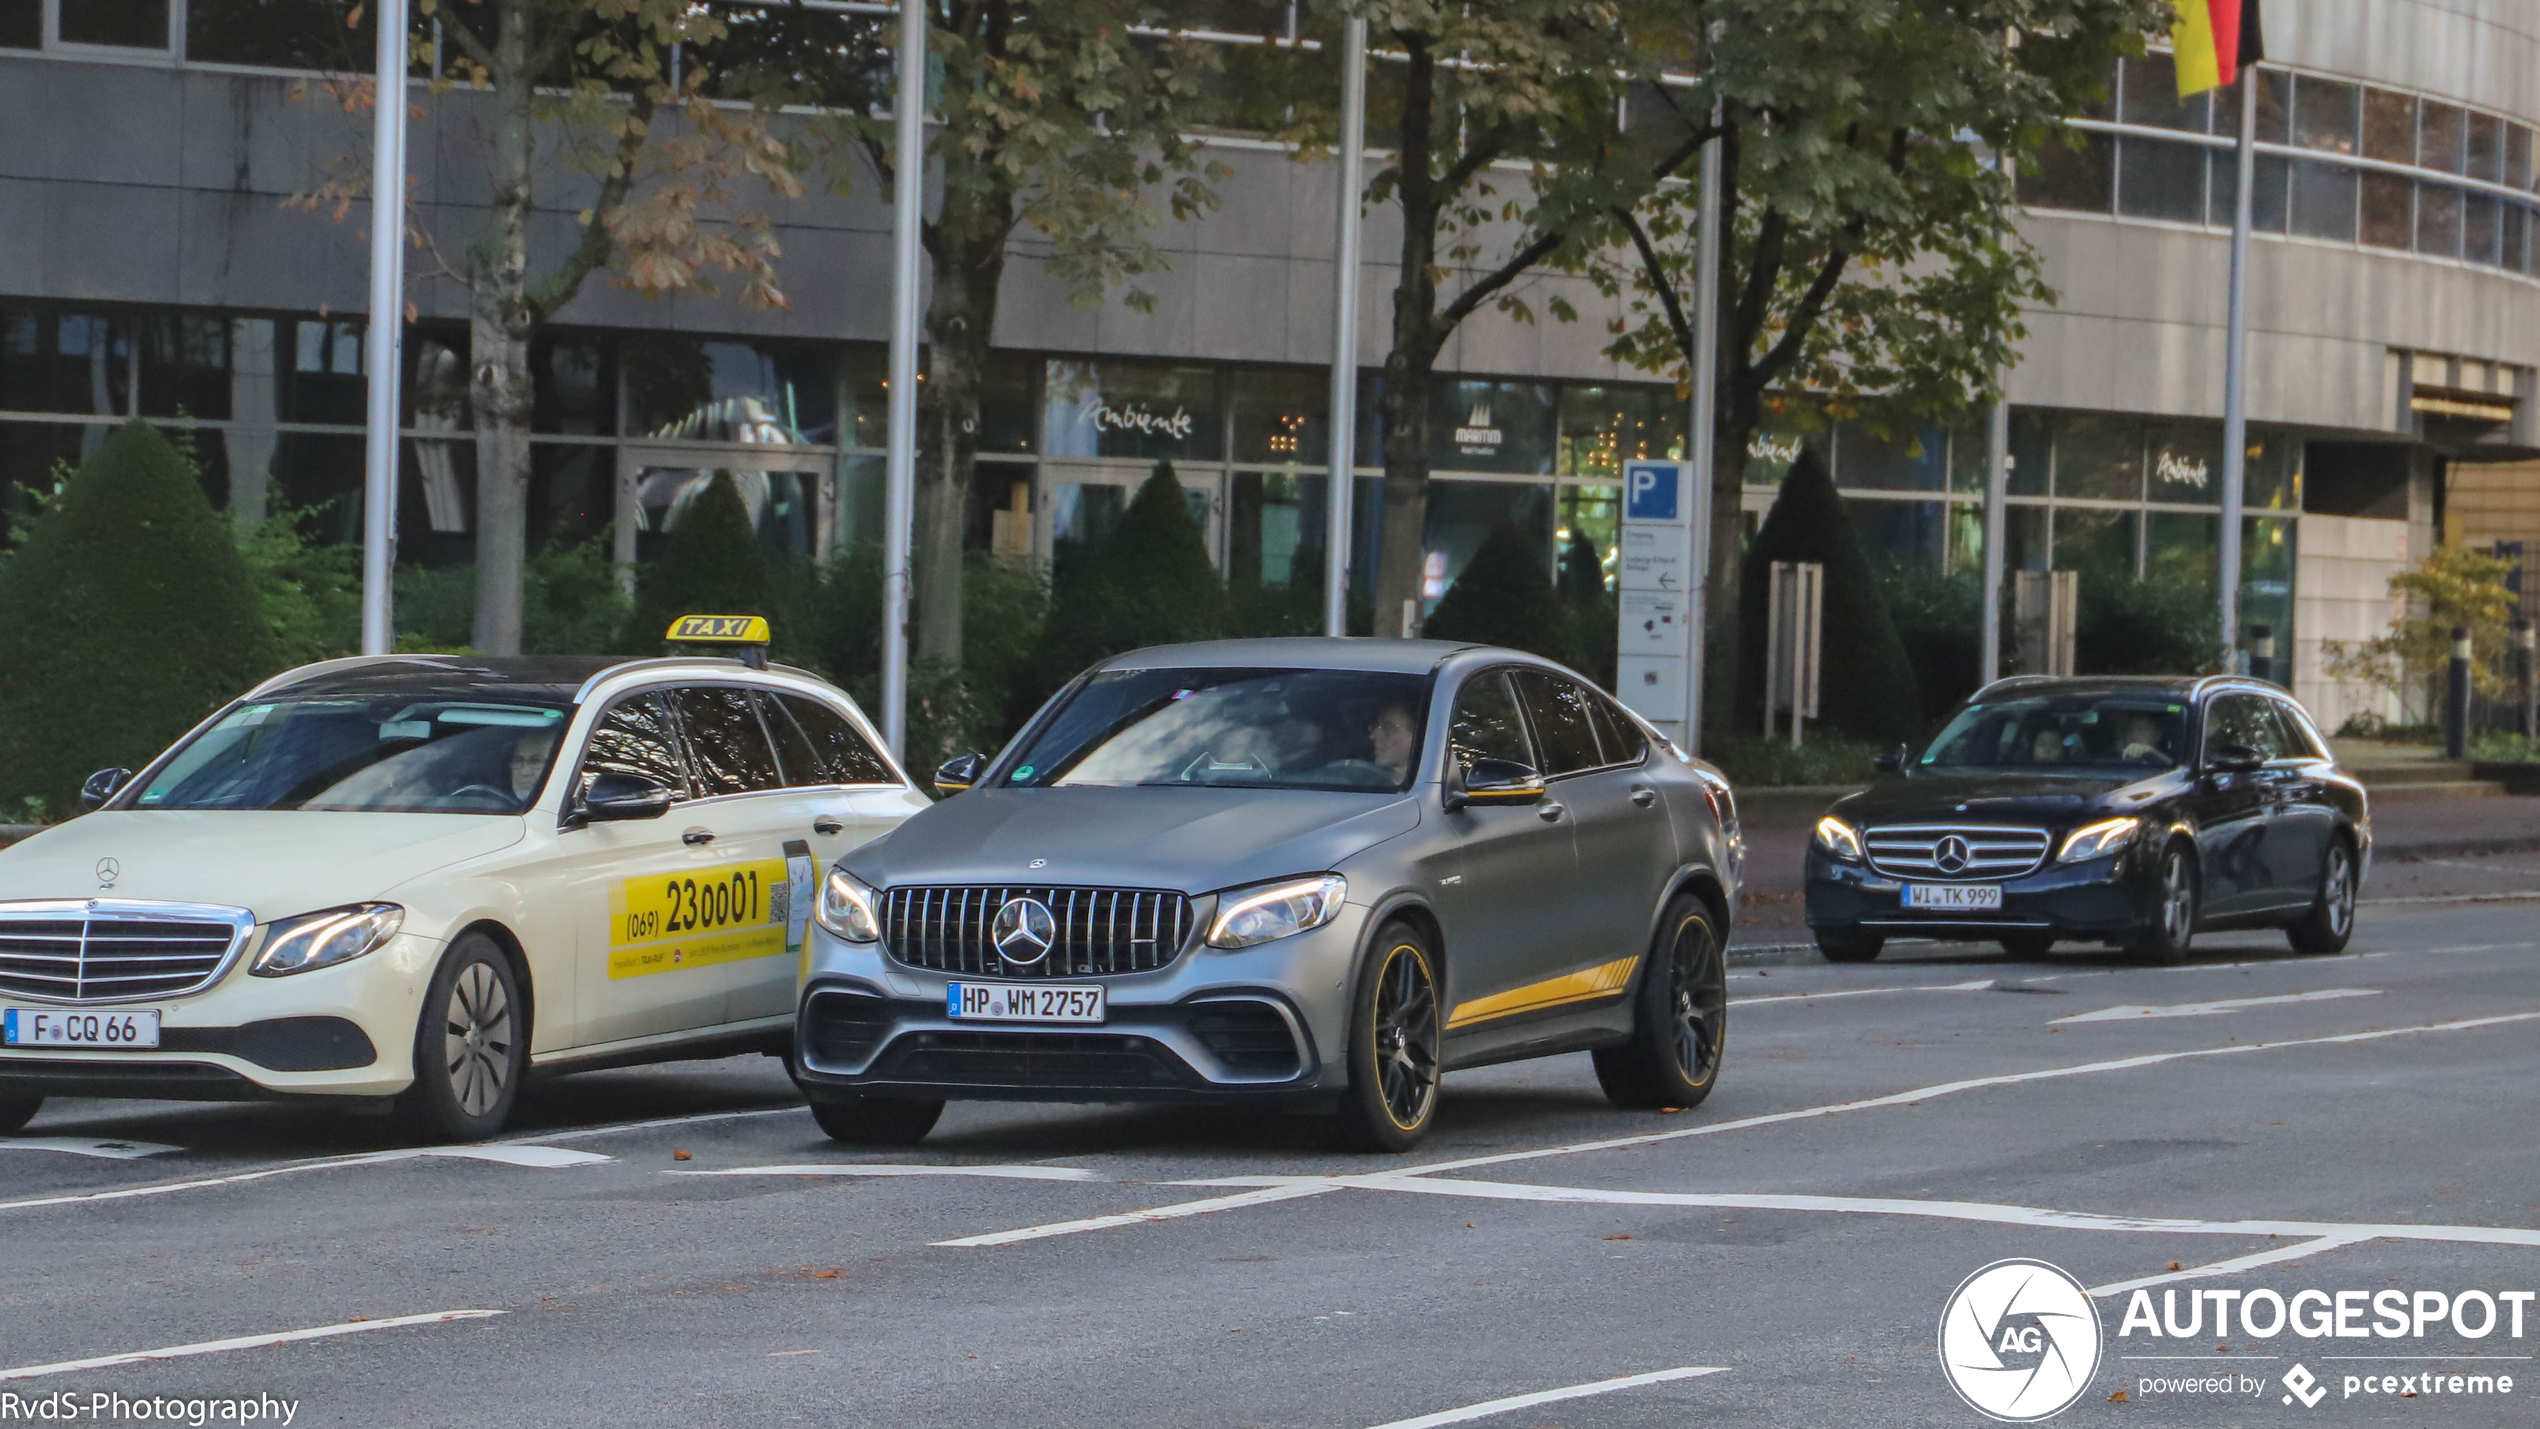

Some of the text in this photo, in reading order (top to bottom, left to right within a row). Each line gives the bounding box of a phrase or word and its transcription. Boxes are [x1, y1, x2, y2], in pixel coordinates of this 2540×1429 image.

[1079, 397, 1192, 439] Ambiente
[1456, 428, 1501, 444] MARITIM
[1632, 470, 1656, 504] P
[684, 619, 749, 636] TAXI
[627, 870, 757, 941] (069) 230001
[1913, 888, 1997, 905] WI TK 999
[963, 987, 1098, 1016] HP WM 2757
[34, 1015, 137, 1042] F CQ 66
